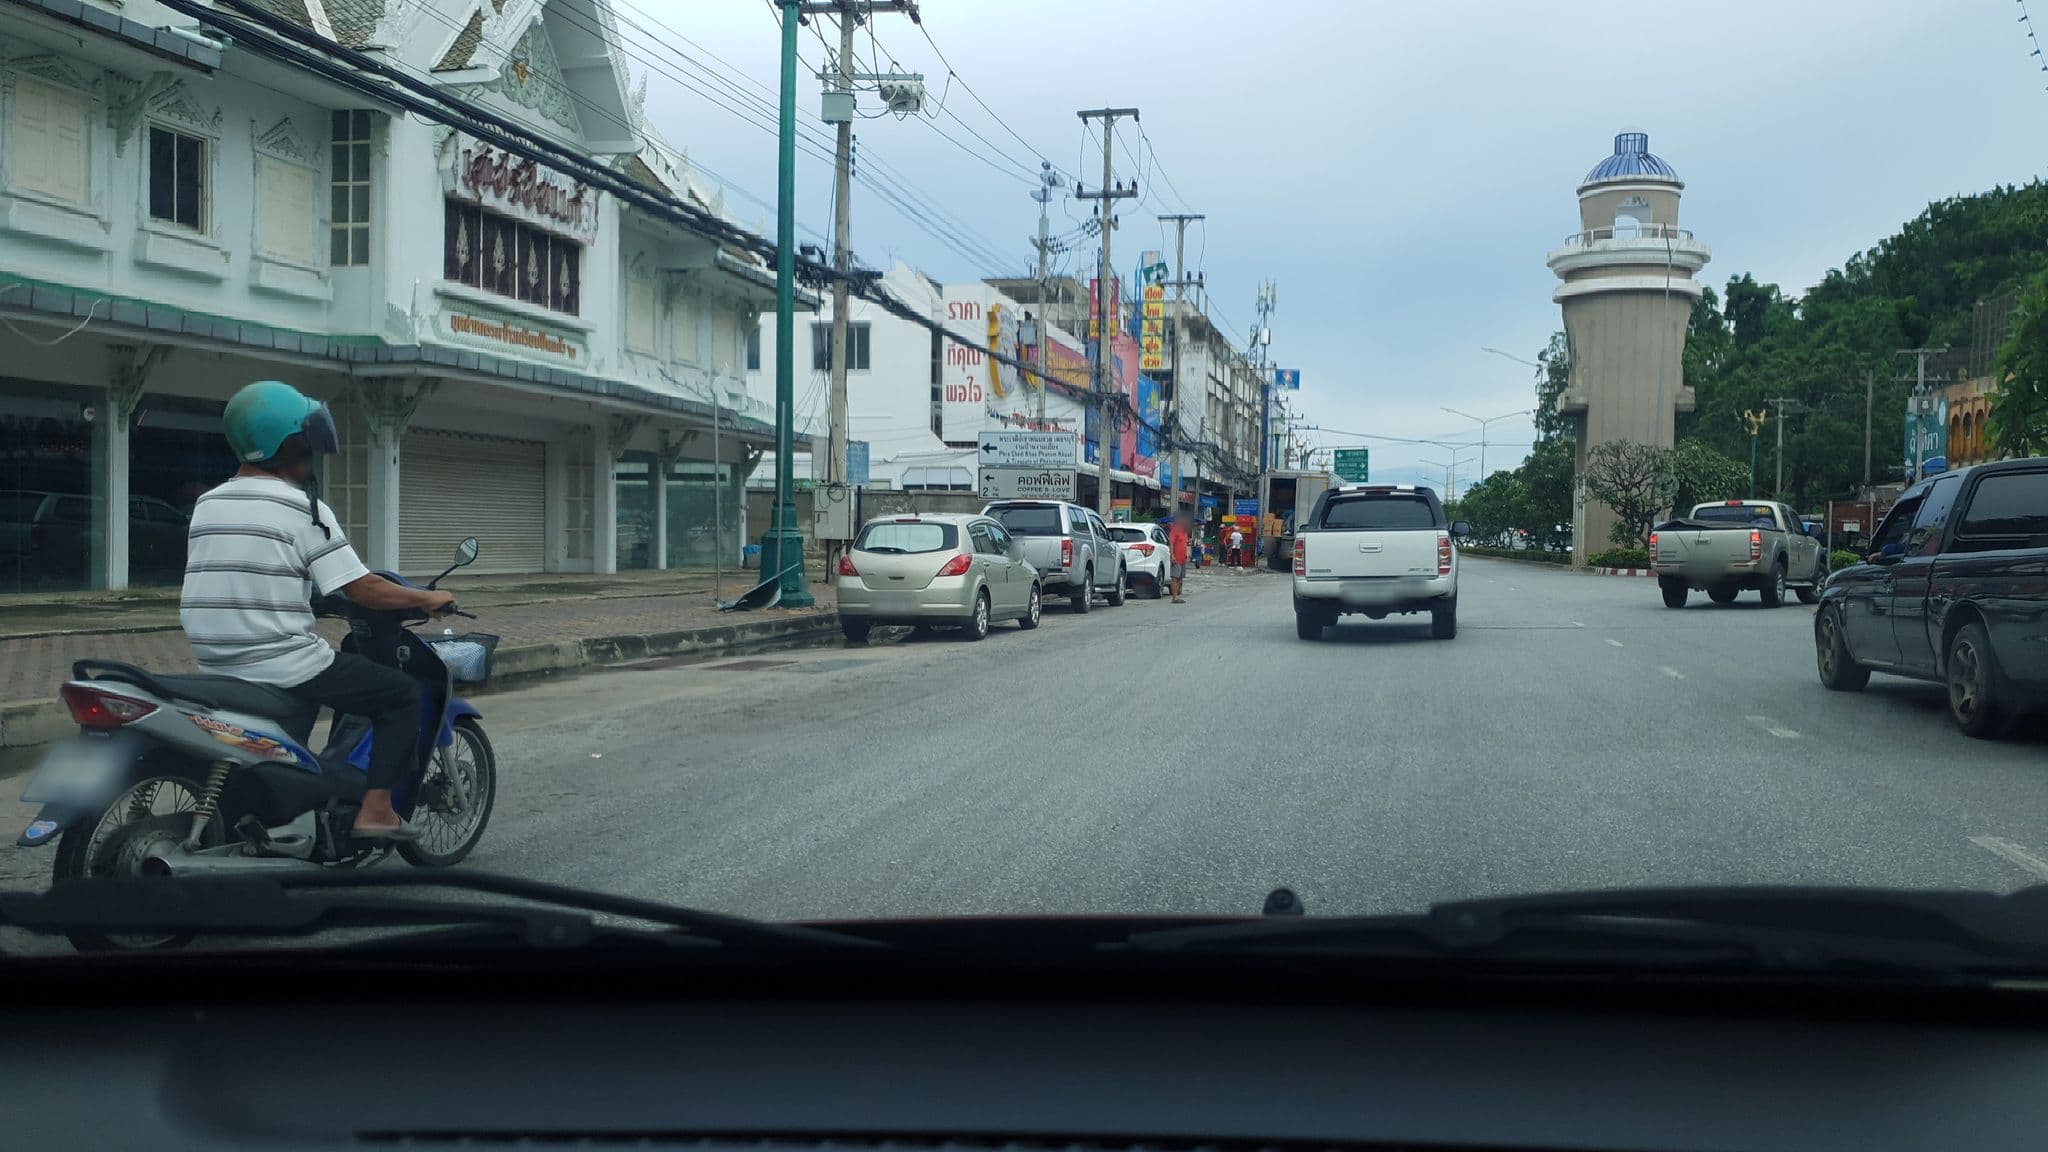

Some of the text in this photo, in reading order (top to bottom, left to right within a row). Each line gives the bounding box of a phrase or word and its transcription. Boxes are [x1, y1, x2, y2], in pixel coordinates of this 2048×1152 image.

[948, 301, 981, 320] ราคา
[946, 375, 982, 402] พอใจ
[982, 486, 989, 497] 2
